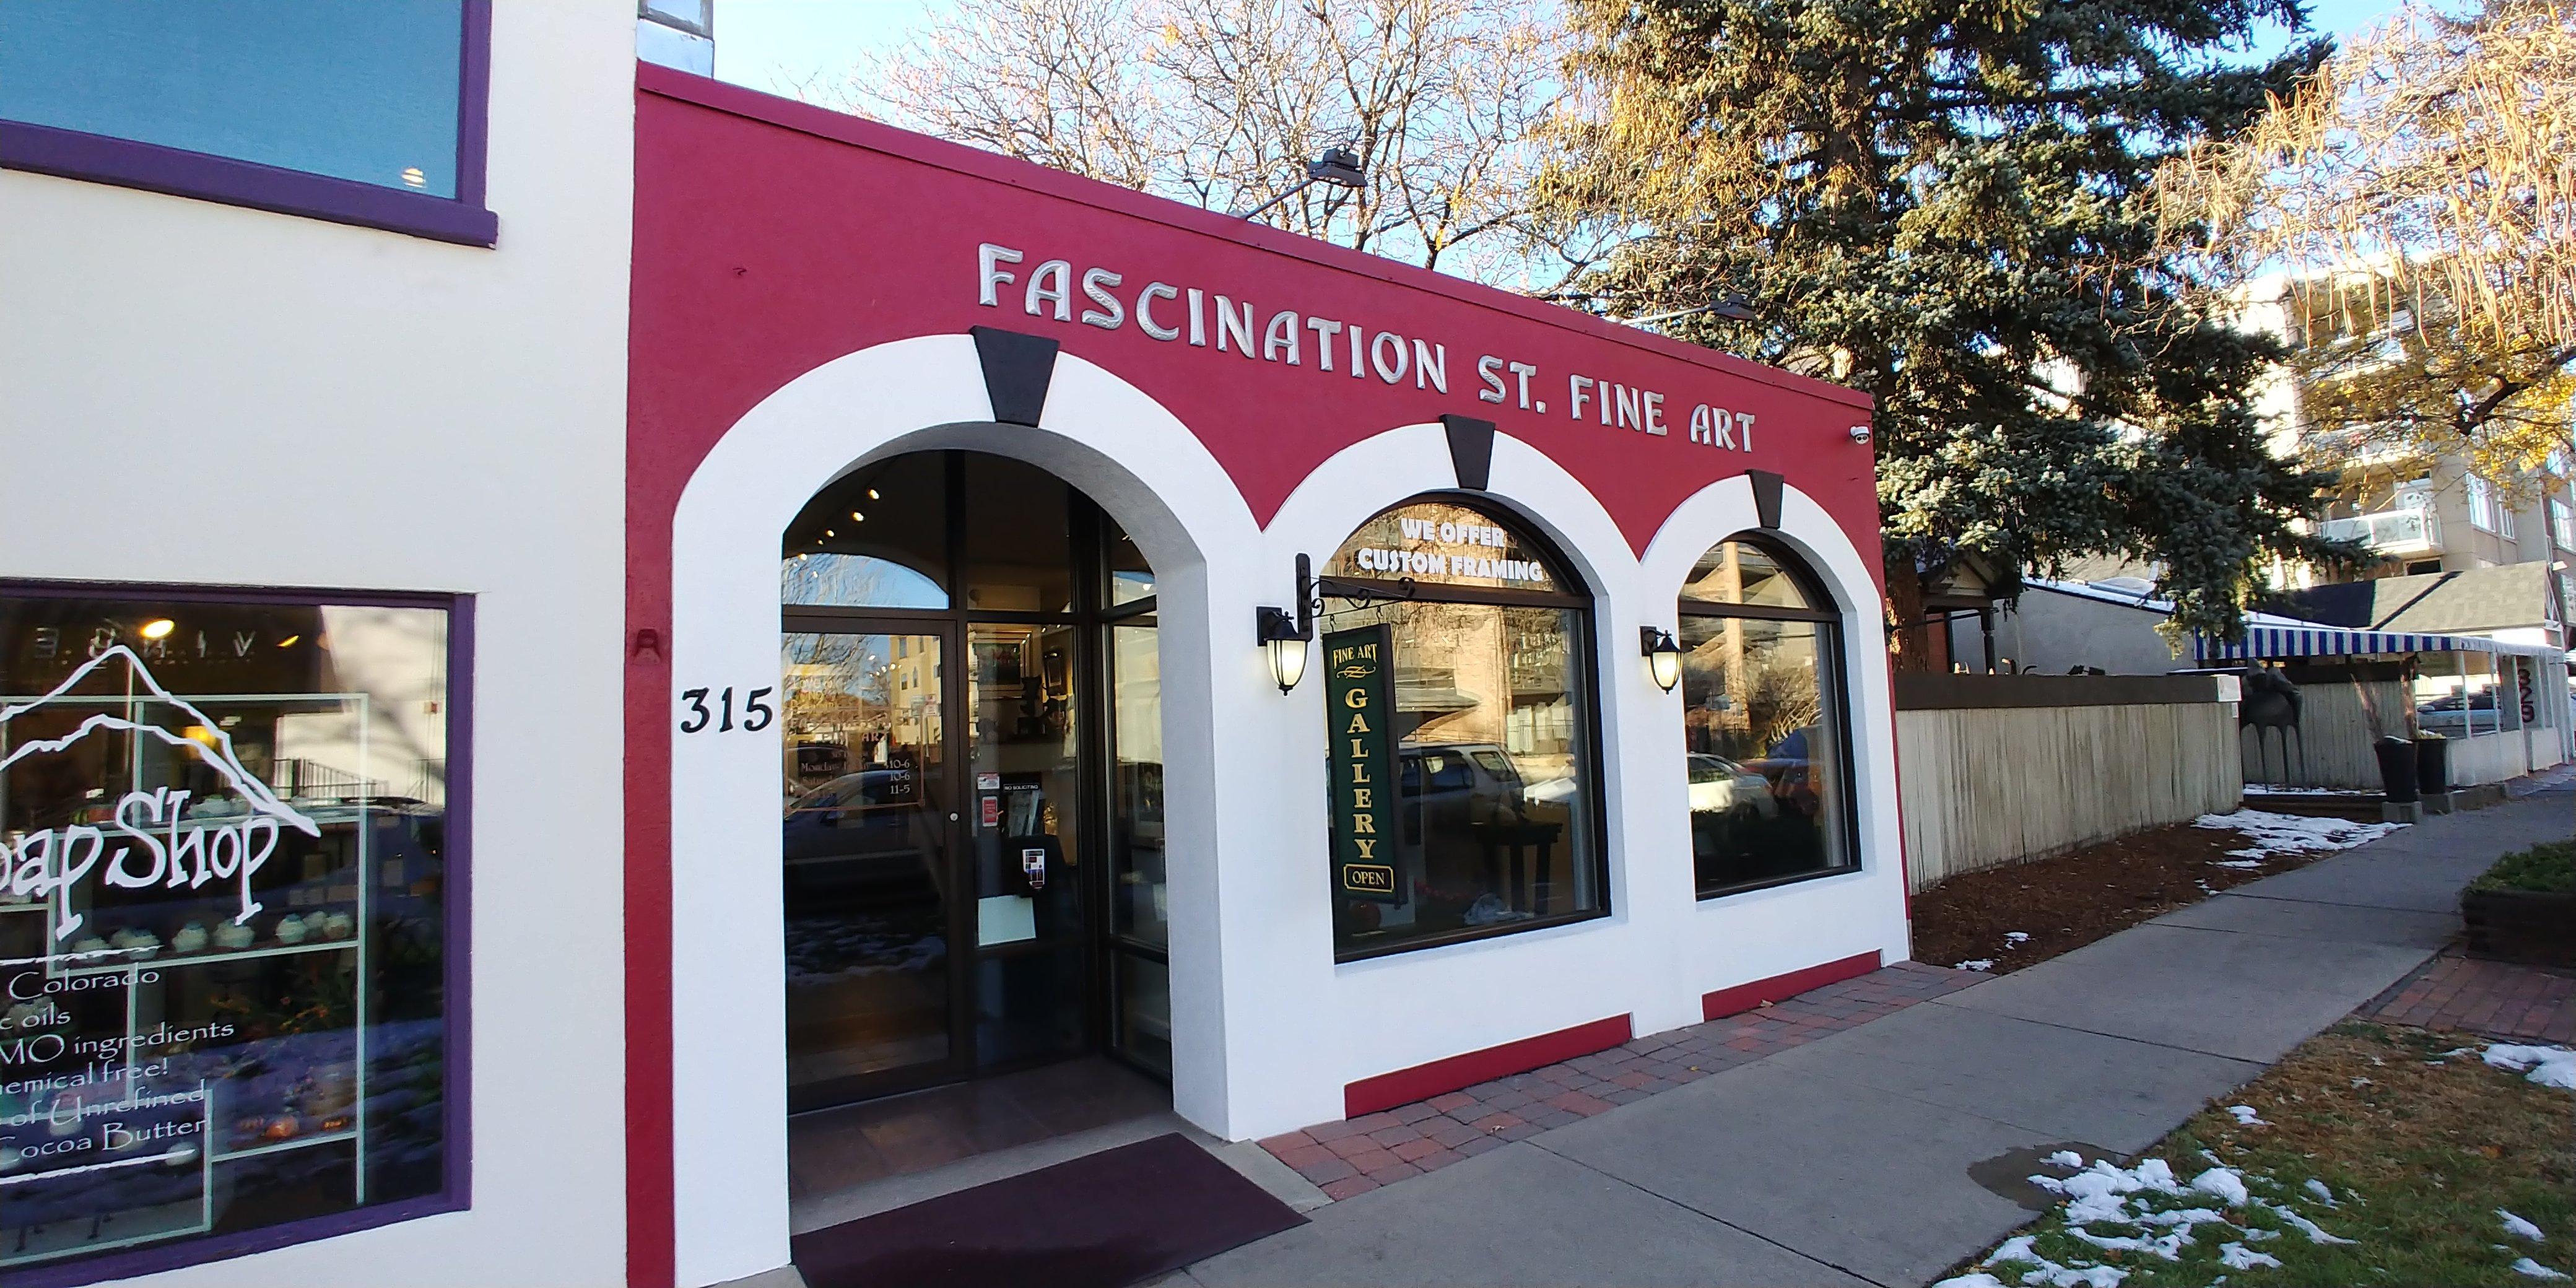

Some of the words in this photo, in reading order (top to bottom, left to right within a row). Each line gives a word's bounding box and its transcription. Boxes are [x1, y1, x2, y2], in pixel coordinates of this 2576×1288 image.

[978, 243, 1447, 394] FASCINATION
[1477, 355, 1546, 414] ST.
[1570, 374, 1668, 437] FINE
[1690, 404, 1756, 453] ART
[1401, 518, 1435, 541] WE
[1440, 522, 1505, 547] OFFER
[1358, 548, 1446, 574] CUSTOM
[1451, 555, 1543, 581] FRAMING
[1333, 646, 1354, 669] FINE
[1357, 643, 1377, 663] ART
[681, 685, 773, 733] 315
[889, 759, 910, 768] 10-6
[890, 772, 910, 781] 10-6
[1345, 688, 1376, 858] GALLERY
[890, 784, 911, 794] 11-5
[105, 786, 279, 926] Shop
[1352, 869, 1385, 886] OPEN
[9, 962, 160, 1000] Colorado
[22, 1002, 71, 1029] oils
[74, 1021, 235, 1060] ingredients
[102, 1057, 168, 1083] free!
[11, 1099, 42, 1126] of
[50, 1078, 206, 1126] Unrefined
